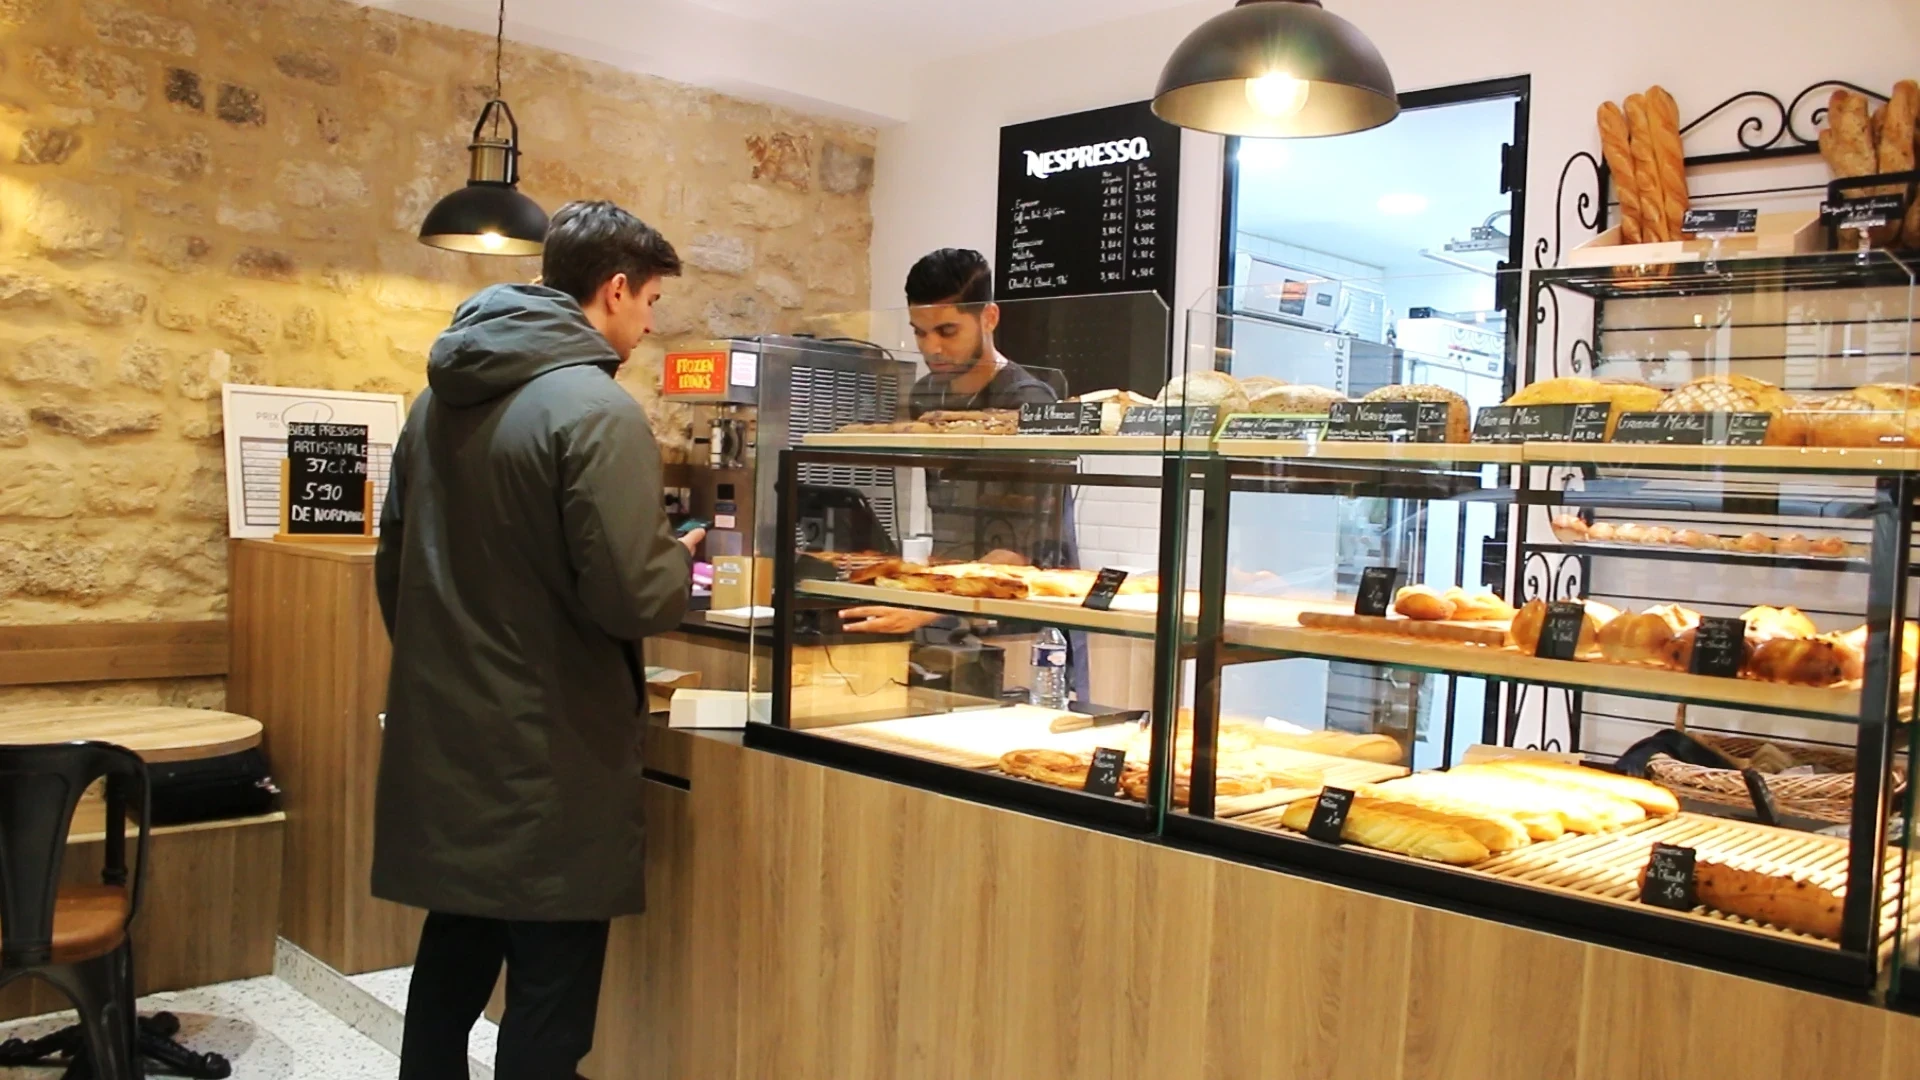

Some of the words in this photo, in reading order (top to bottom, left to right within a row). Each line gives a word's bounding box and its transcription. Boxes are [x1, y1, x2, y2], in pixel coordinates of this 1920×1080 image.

[676, 357, 715, 374] FROZEN
[319, 425, 366, 437] PRESSION
[294, 440, 367, 457] ARTISANALE
[291, 504, 311, 521] DE
